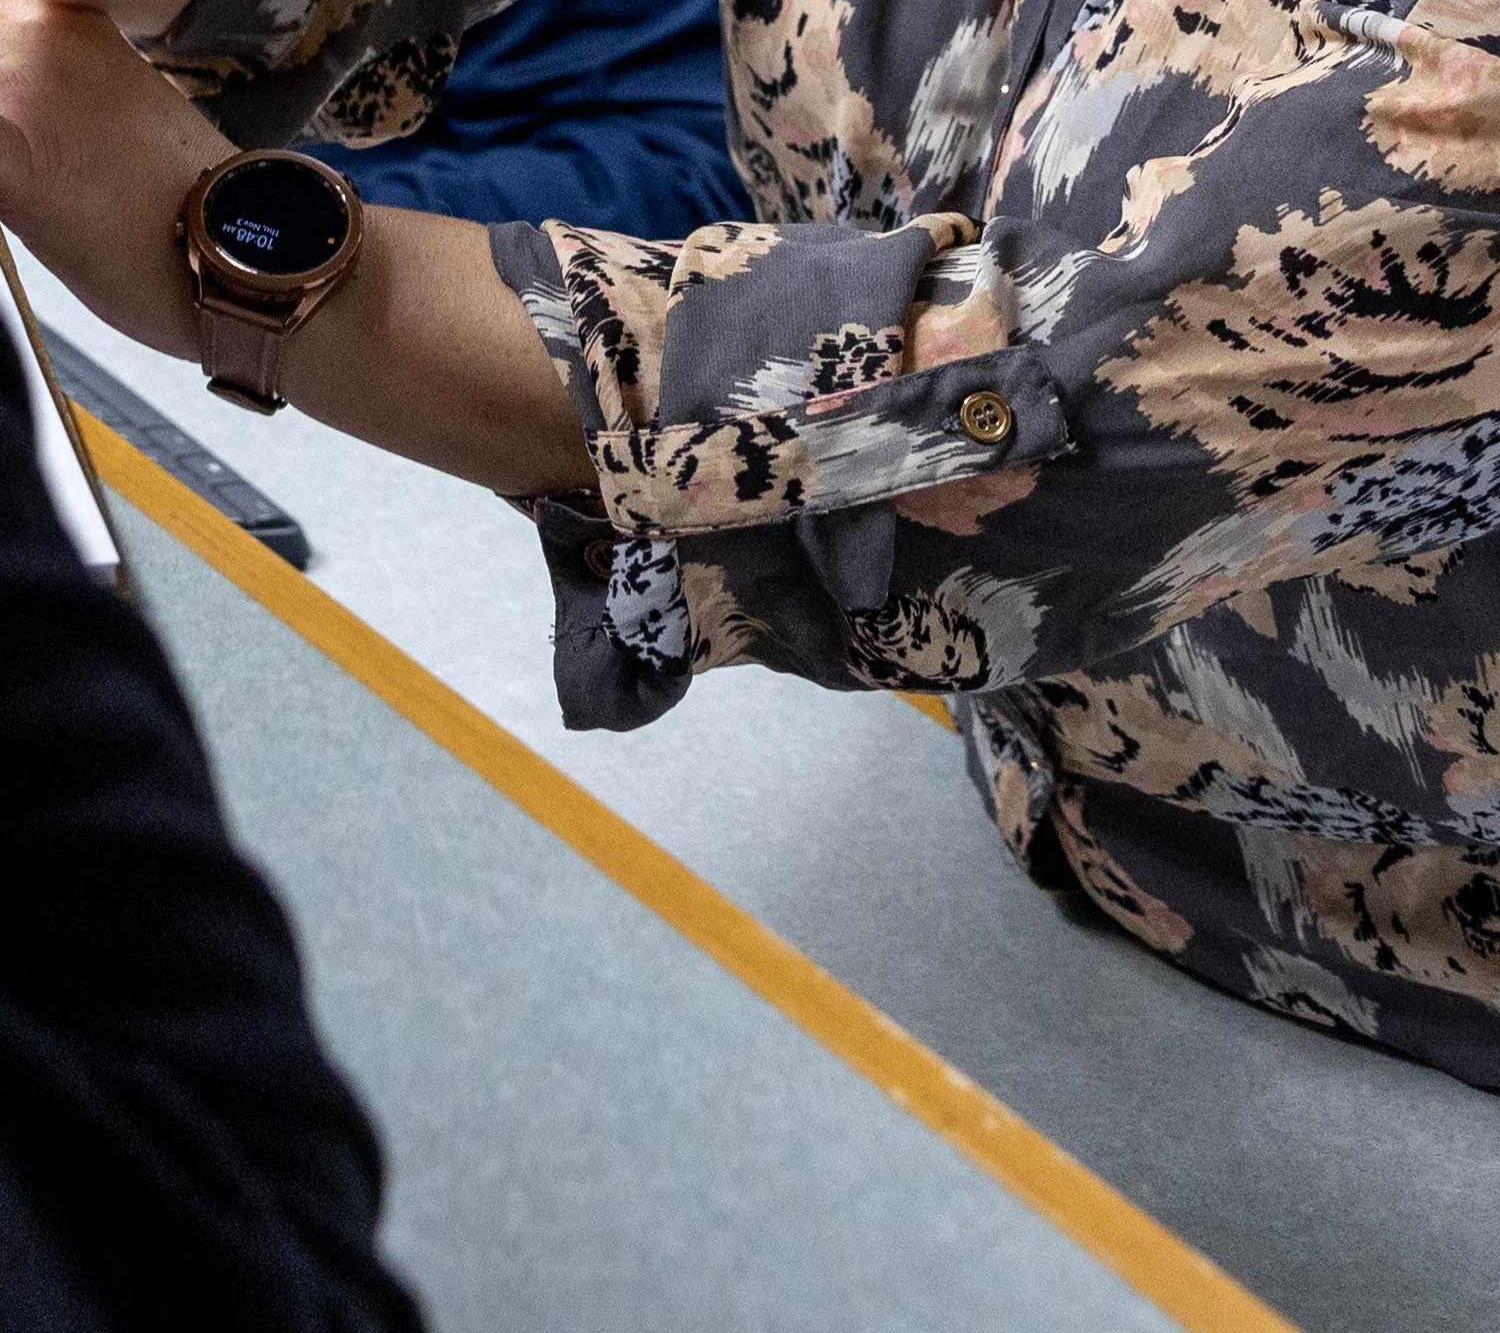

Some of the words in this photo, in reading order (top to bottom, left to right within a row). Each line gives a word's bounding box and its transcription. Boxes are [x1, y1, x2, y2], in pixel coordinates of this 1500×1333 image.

[236, 218, 243, 226] 3
[243, 220, 261, 231] Nov
[222, 223, 237, 233] AM
[263, 224, 280, 237] Thu,
[236, 228, 274, 250] 10:48
